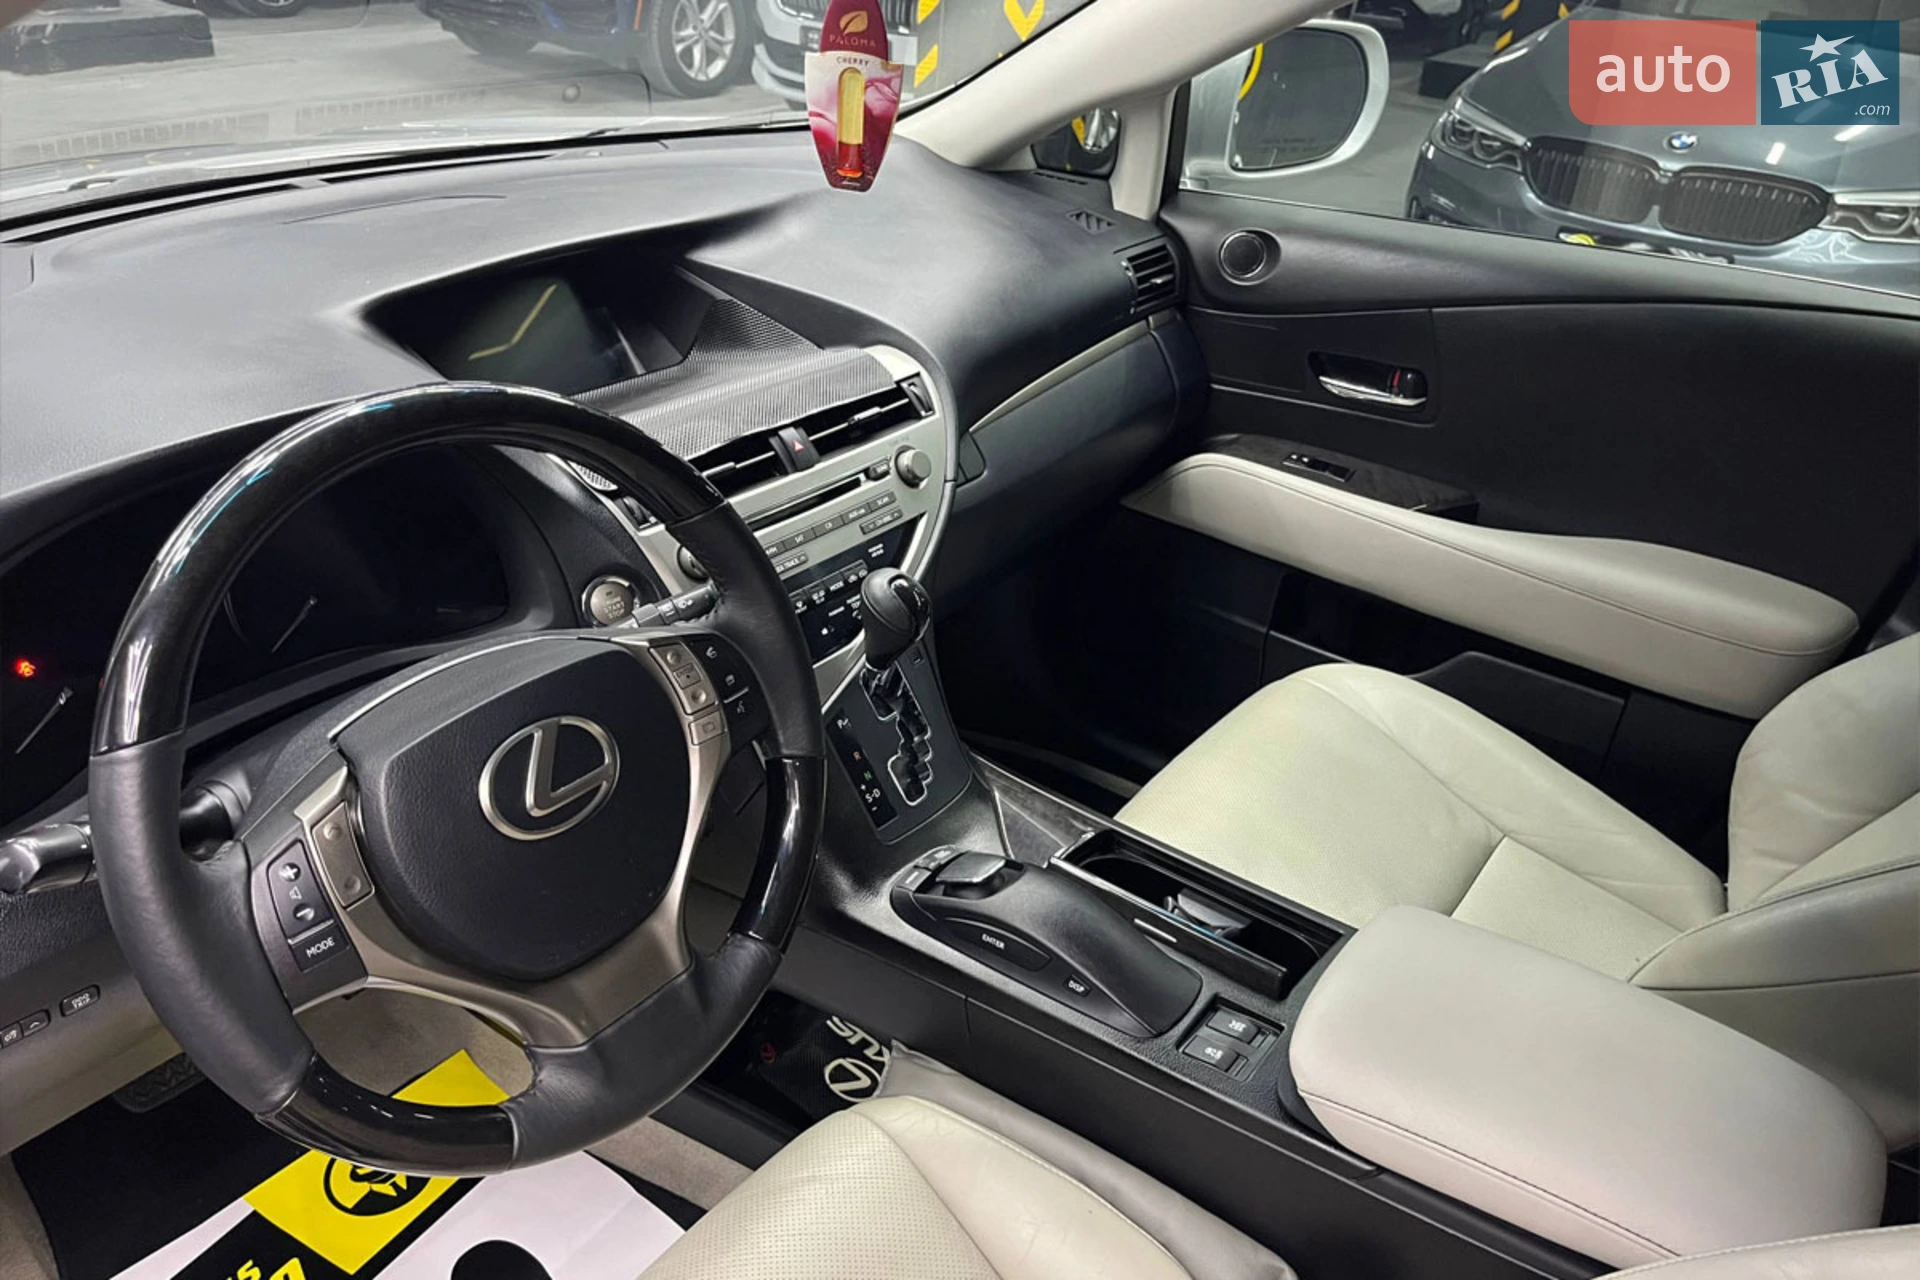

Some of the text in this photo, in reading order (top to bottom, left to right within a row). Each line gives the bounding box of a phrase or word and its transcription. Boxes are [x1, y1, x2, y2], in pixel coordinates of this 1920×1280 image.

[829, 34, 877, 48] PALOMA
[836, 55, 870, 67] CHERRY
[603, 601, 625, 614] START
[852, 751, 862, 761] R
[863, 769, 873, 781] N
[305, 937, 335, 958] MODE
[981, 933, 1005, 950] ENTER
[1068, 979, 1085, 993] DISP
